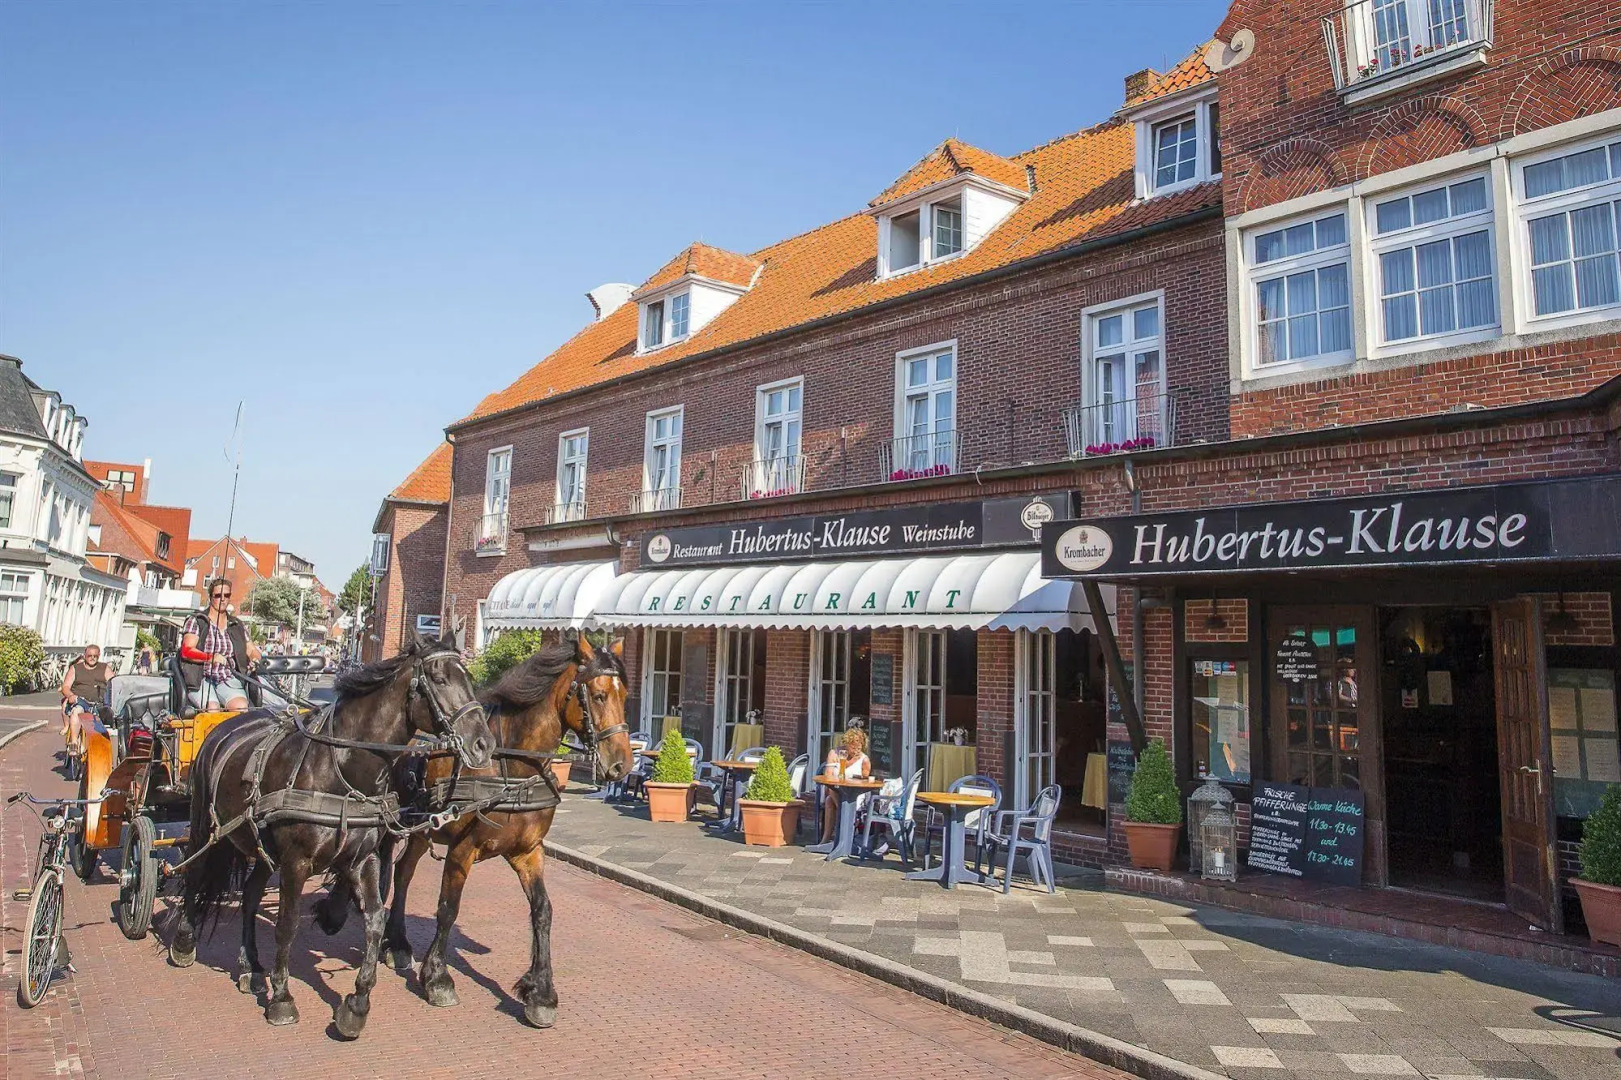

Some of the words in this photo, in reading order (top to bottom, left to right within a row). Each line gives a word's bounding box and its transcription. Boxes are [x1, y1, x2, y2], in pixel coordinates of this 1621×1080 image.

[672, 541, 723, 558] Restaurant
[728, 517, 891, 555] Hubertus-Klause
[901, 520, 976, 543] Weinstube
[1130, 501, 1528, 564] Hubertus-Klause
[1064, 545, 1106, 559] Krombacher
[648, 590, 961, 611] RESTAURANT
[1263, 787, 1296, 801] FRISCHE
[1334, 800, 1362, 816] Küche
[1334, 821, 1357, 836] 13.45
[1320, 837, 1338, 846] und
